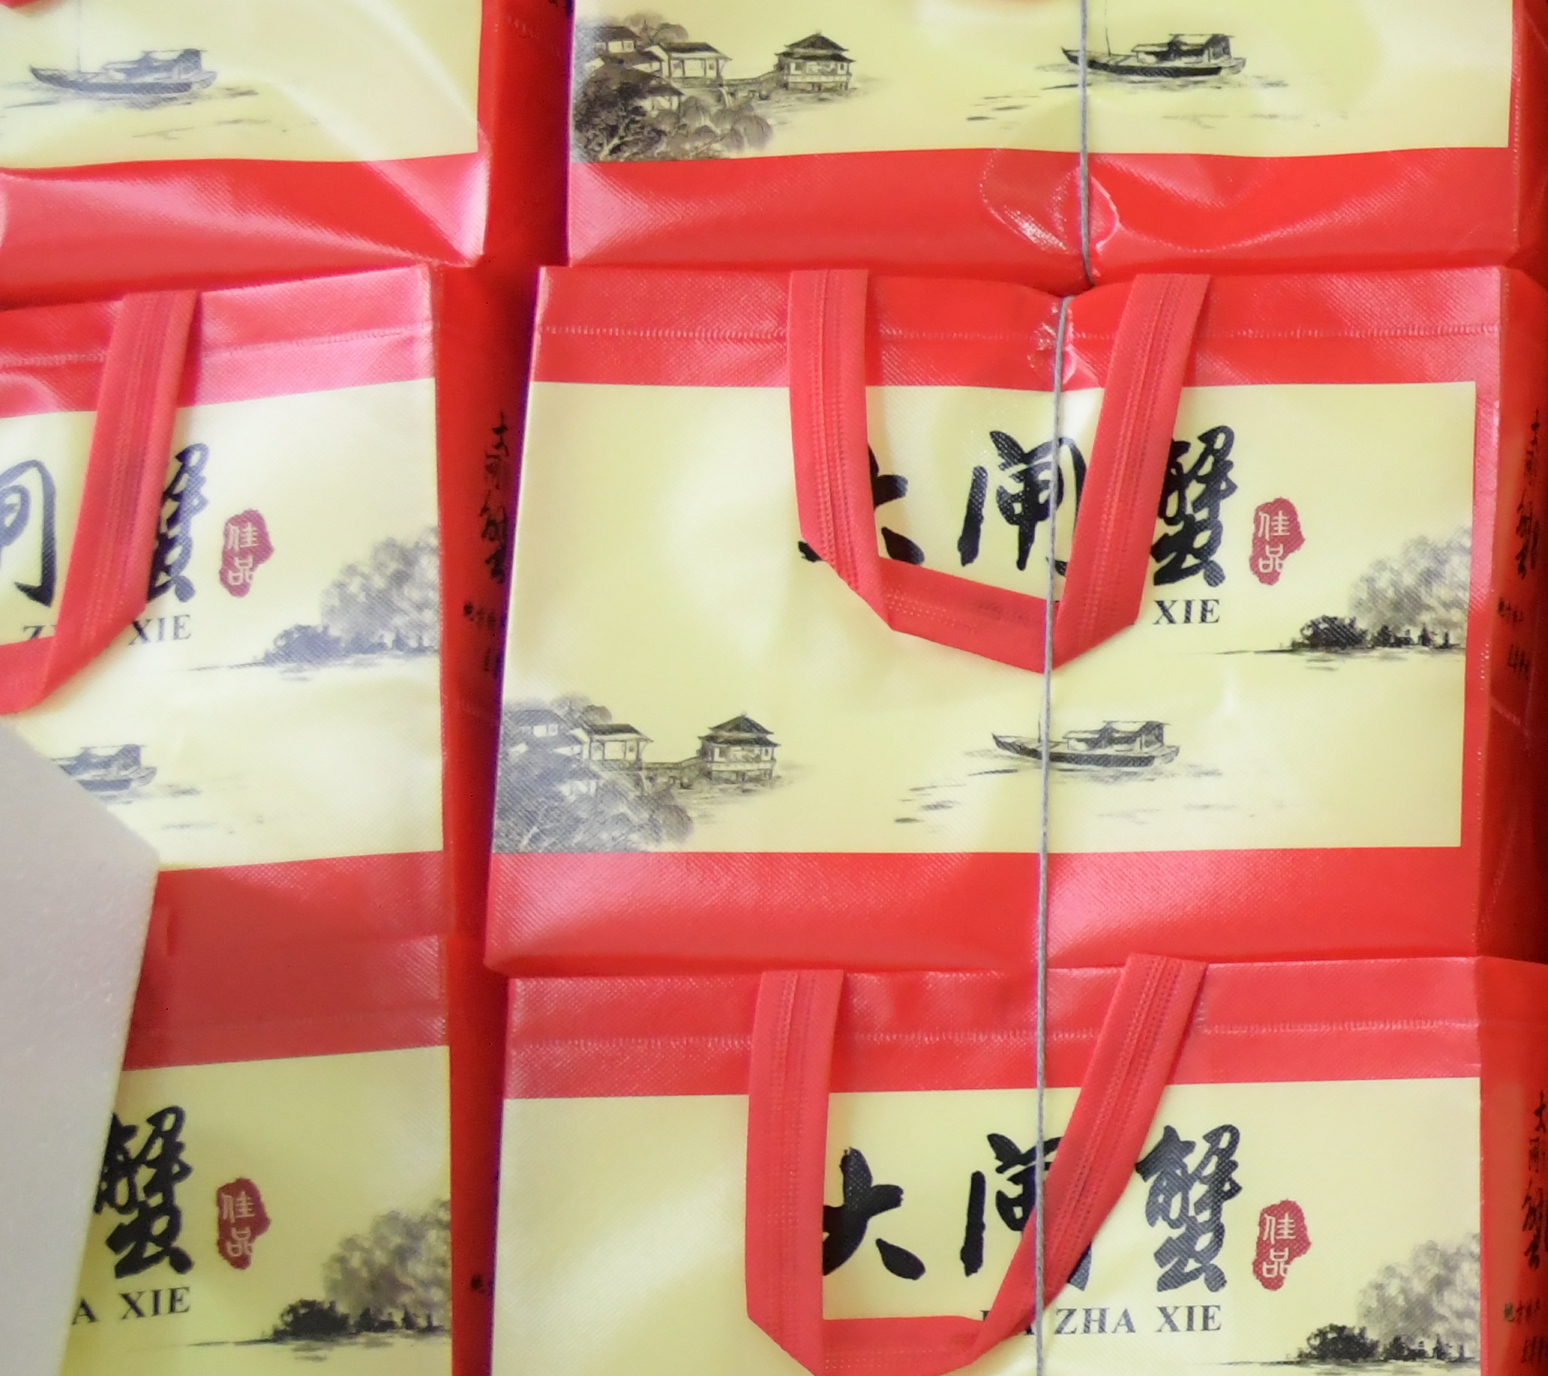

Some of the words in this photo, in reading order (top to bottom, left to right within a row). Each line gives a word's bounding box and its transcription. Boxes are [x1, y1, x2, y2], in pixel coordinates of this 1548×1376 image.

[225, 522, 259, 588] 佳品
[1257, 508, 1290, 576] 佳品
[1153, 600, 1222, 626] XIE
[220, 1192, 256, 1261] 佳品
[1261, 1212, 1295, 1278] 佳品
[120, 1286, 192, 1322] XIE
[1054, 1304, 1135, 1336] ZHA
[1156, 1303, 1222, 1335] XIE
